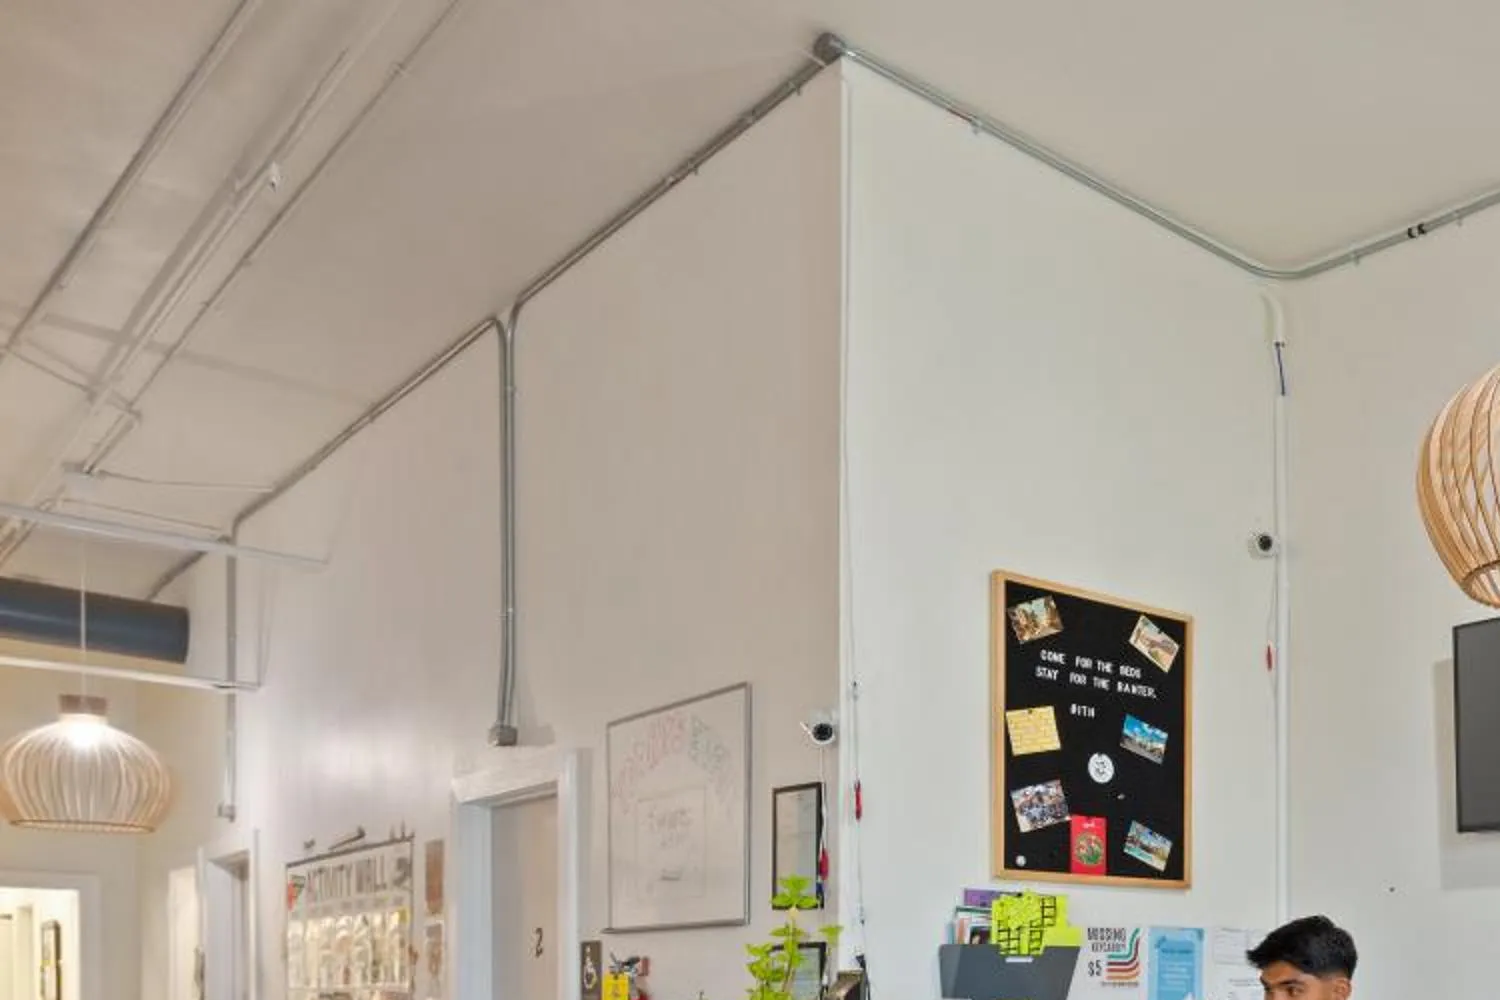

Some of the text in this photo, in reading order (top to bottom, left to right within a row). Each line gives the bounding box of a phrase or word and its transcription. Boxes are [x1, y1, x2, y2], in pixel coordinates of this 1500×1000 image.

[1075, 656, 1093, 669] FOR
[1097, 660, 1113, 673] THE
[1035, 666, 1059, 680] STAY
[1068, 672, 1087, 685] FOR
[1093, 676, 1110, 690] THE
[535, 927, 543, 958] 2
[1087, 960, 1102, 977] $5
